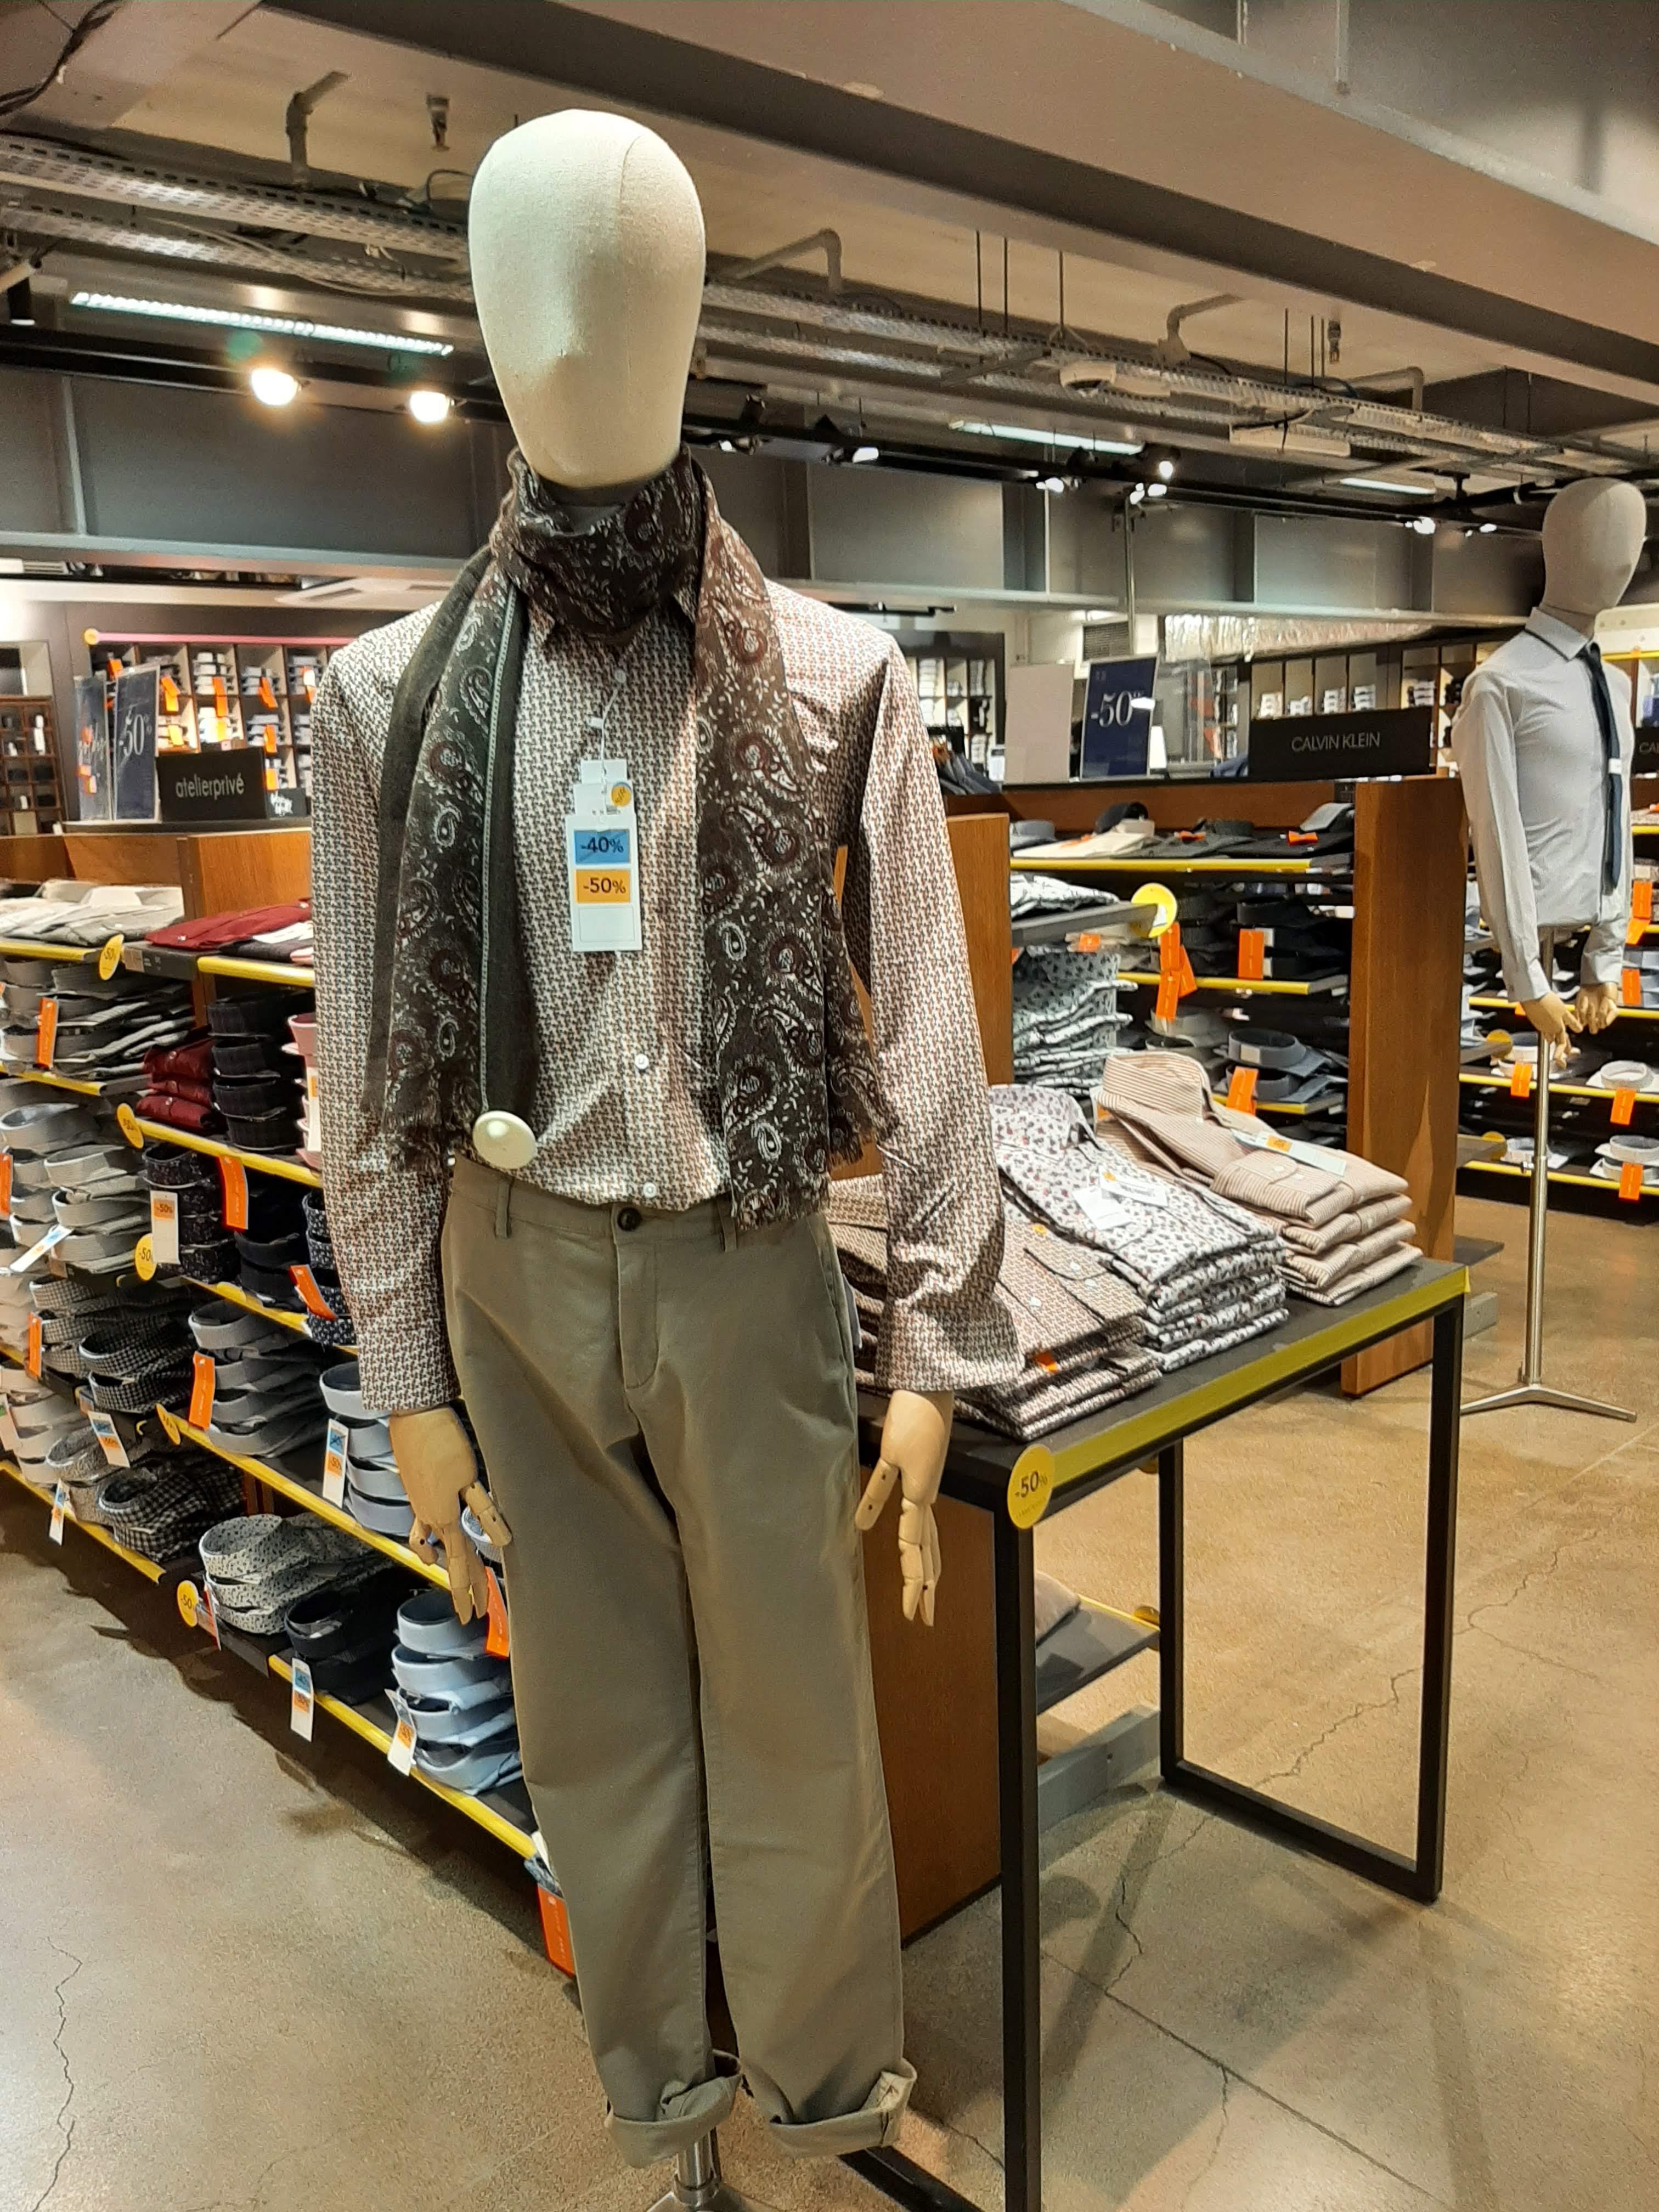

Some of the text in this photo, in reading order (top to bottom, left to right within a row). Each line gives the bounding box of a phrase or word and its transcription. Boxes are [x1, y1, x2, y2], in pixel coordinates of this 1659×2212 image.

[1291, 731, 1381, 752] CALVIN KLEIN
[176, 772, 245, 800] atelierprivé
[581, 837, 624, 854] -40%
[583, 877, 627, 894] -50%
[139, 1246, 153, 1261] -50
[1014, 1471, 1048, 1498] -50%
